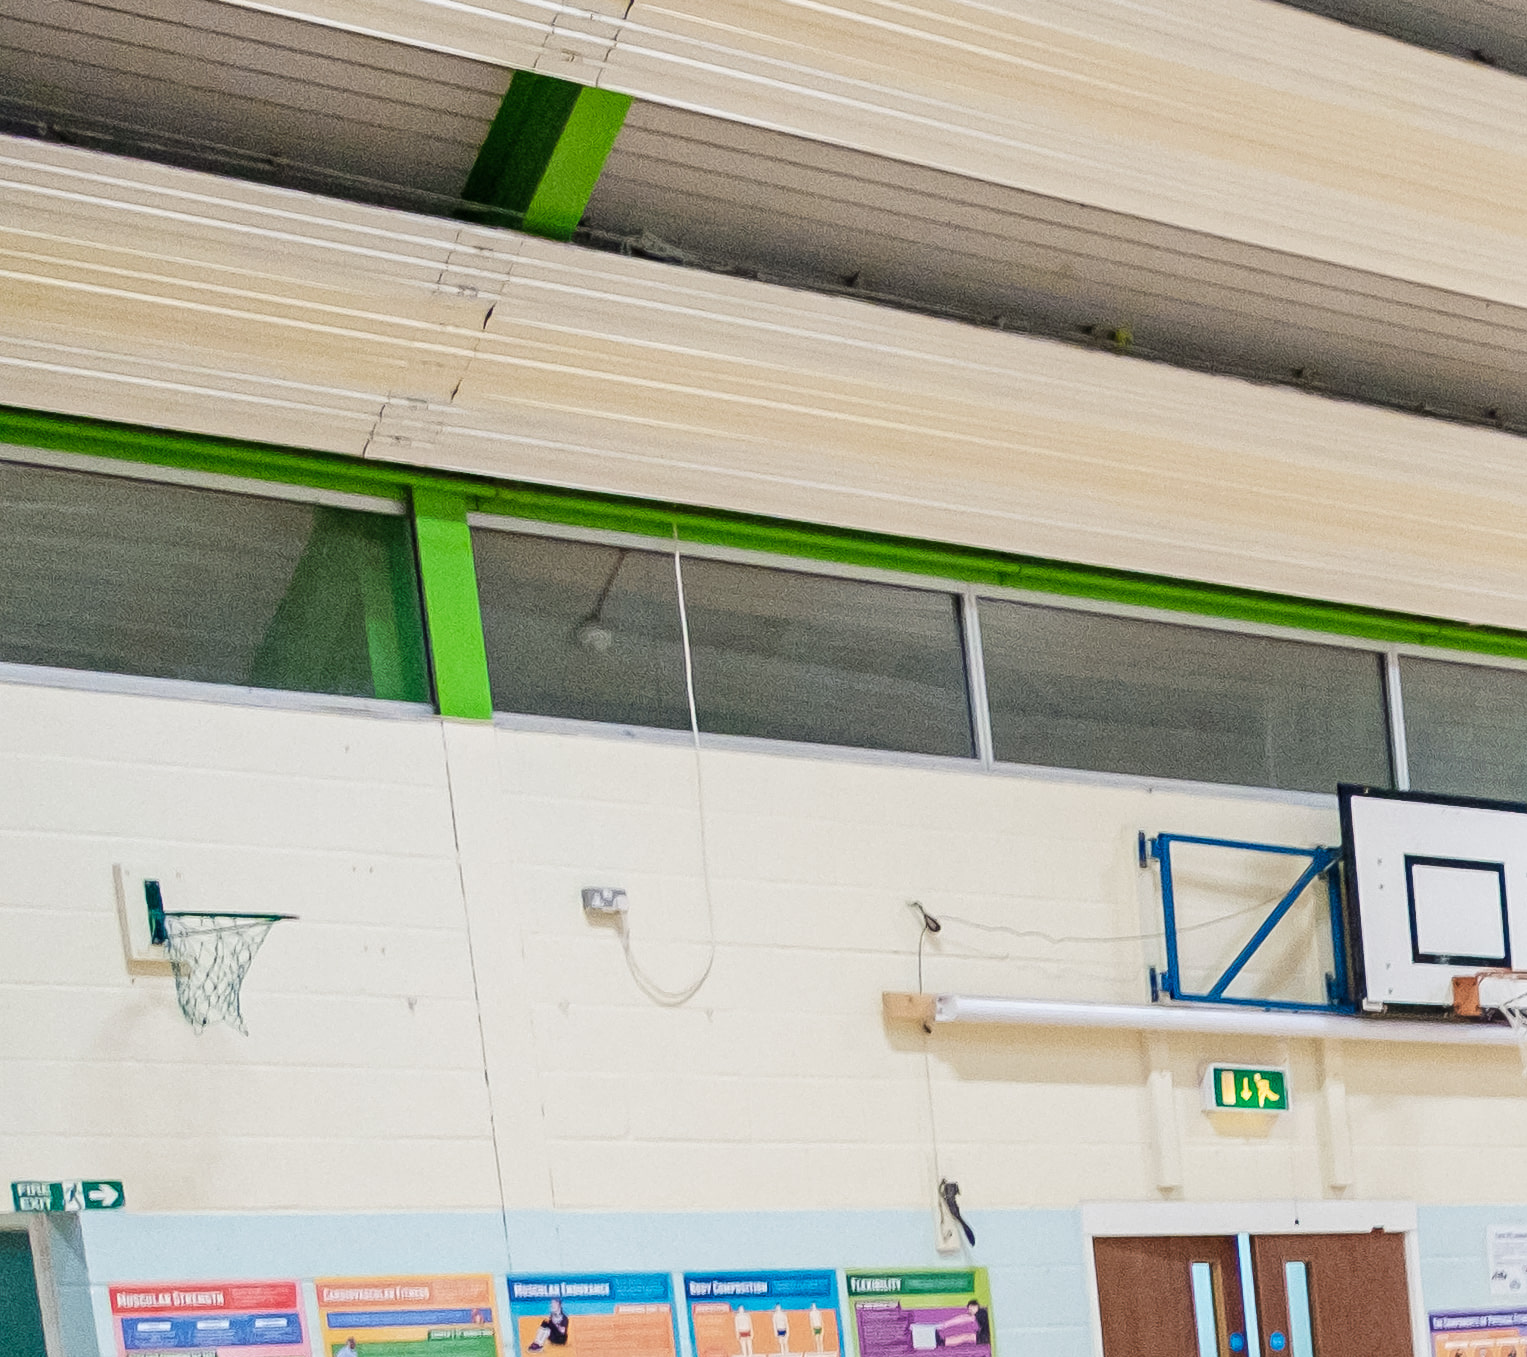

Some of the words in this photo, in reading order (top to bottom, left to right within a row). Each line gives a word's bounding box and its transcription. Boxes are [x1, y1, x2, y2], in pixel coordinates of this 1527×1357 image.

[17, 1182, 51, 1198] FIRE
[18, 1196, 52, 1211] EXIT
[514, 1282, 561, 1299] MUSCULAR
[688, 1281, 712, 1296] BODY
[712, 1281, 768, 1296] COMPOSITION
[850, 1277, 902, 1293] FLEXIBILITY
[116, 1292, 172, 1309] MUSCULAR
[172, 1290, 225, 1307] STRENGTH
